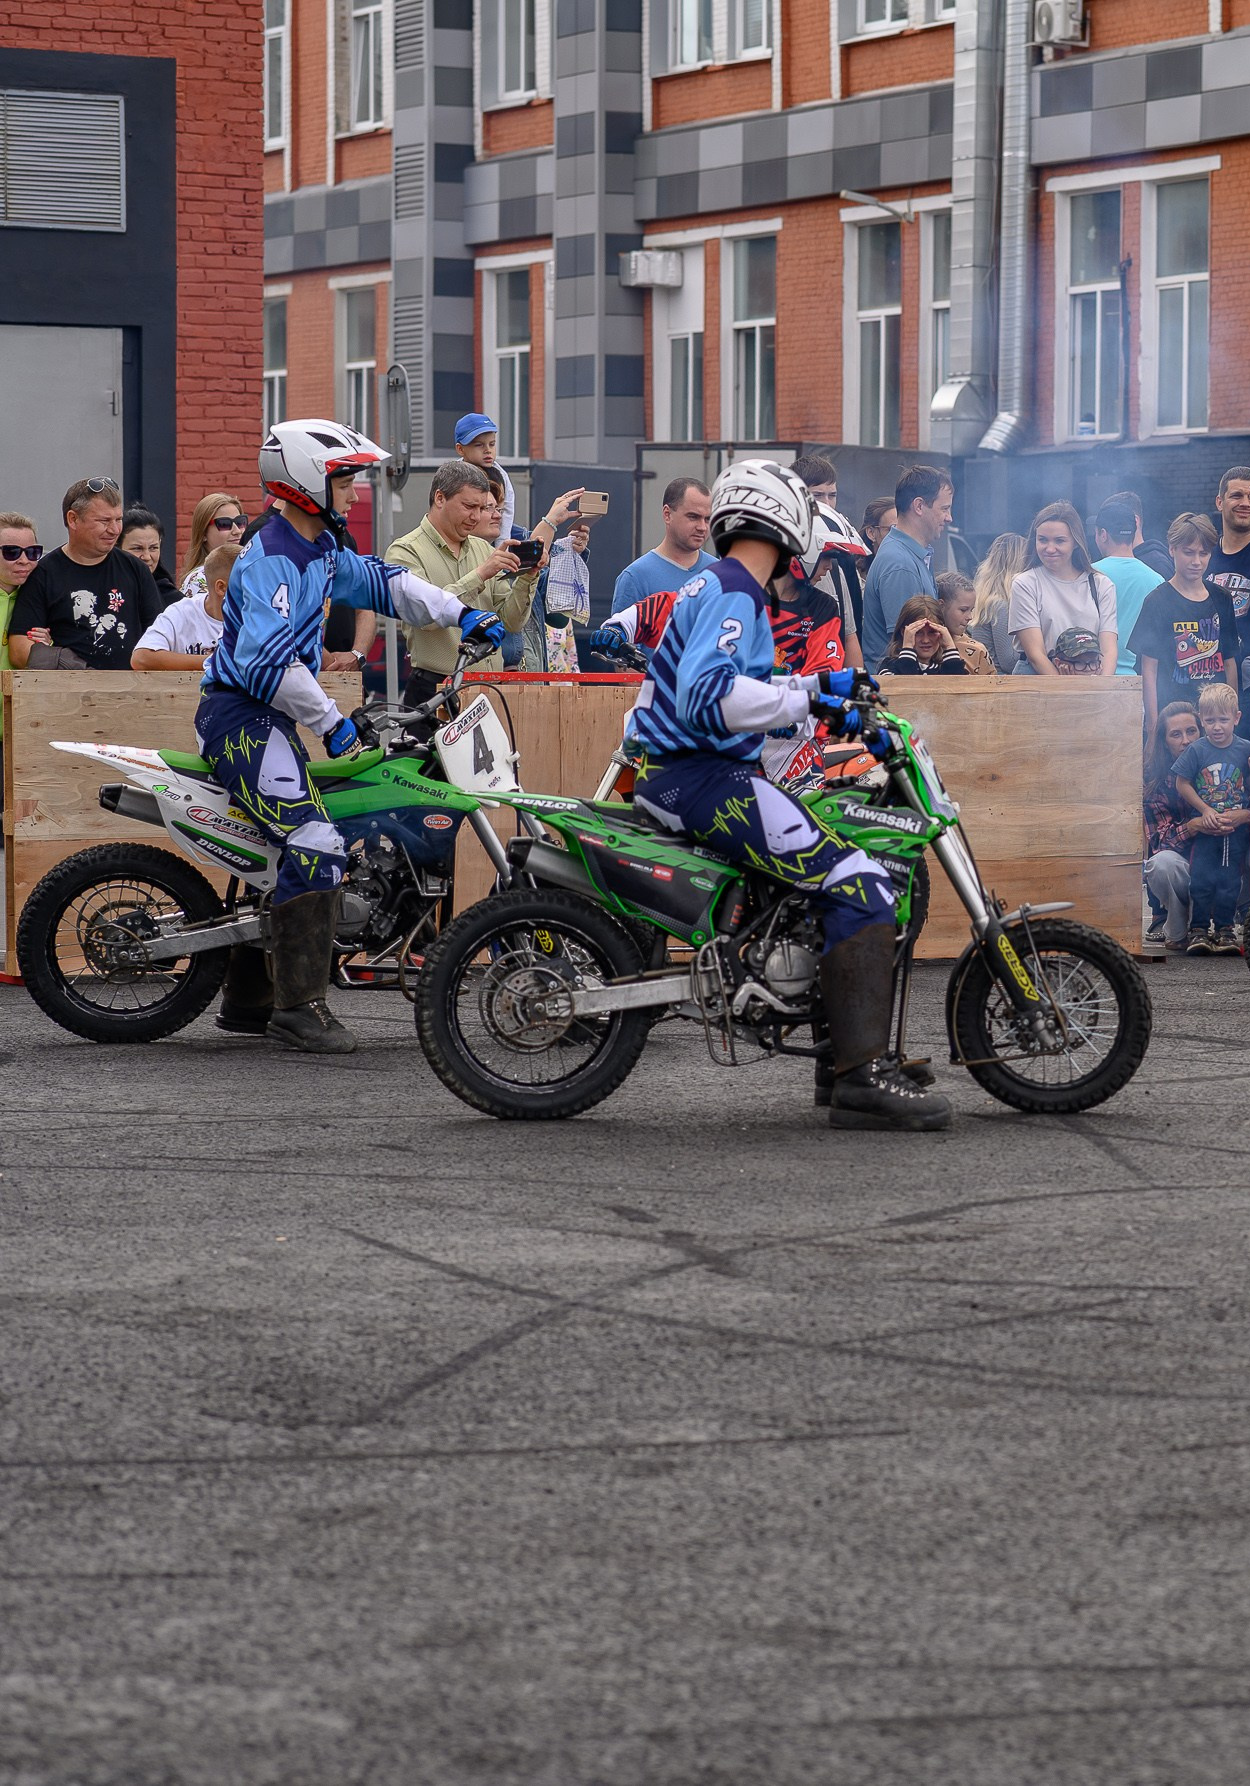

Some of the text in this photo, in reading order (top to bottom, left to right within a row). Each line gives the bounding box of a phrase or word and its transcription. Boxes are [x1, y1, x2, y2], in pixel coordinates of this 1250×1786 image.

[278, 483, 310, 507] MOTS
[108, 592, 122, 600] DM
[271, 583, 290, 618] 4
[717, 617, 743, 657] 2
[1176, 623, 1198, 631] ALL
[826, 640, 841, 659] 2
[473, 723, 495, 776] 4
[392, 774, 449, 801] Kawasaki
[510, 797, 578, 810] DUNLOP
[844, 803, 923, 834] Kawasaki
[196, 838, 252, 866] DUNLOP
